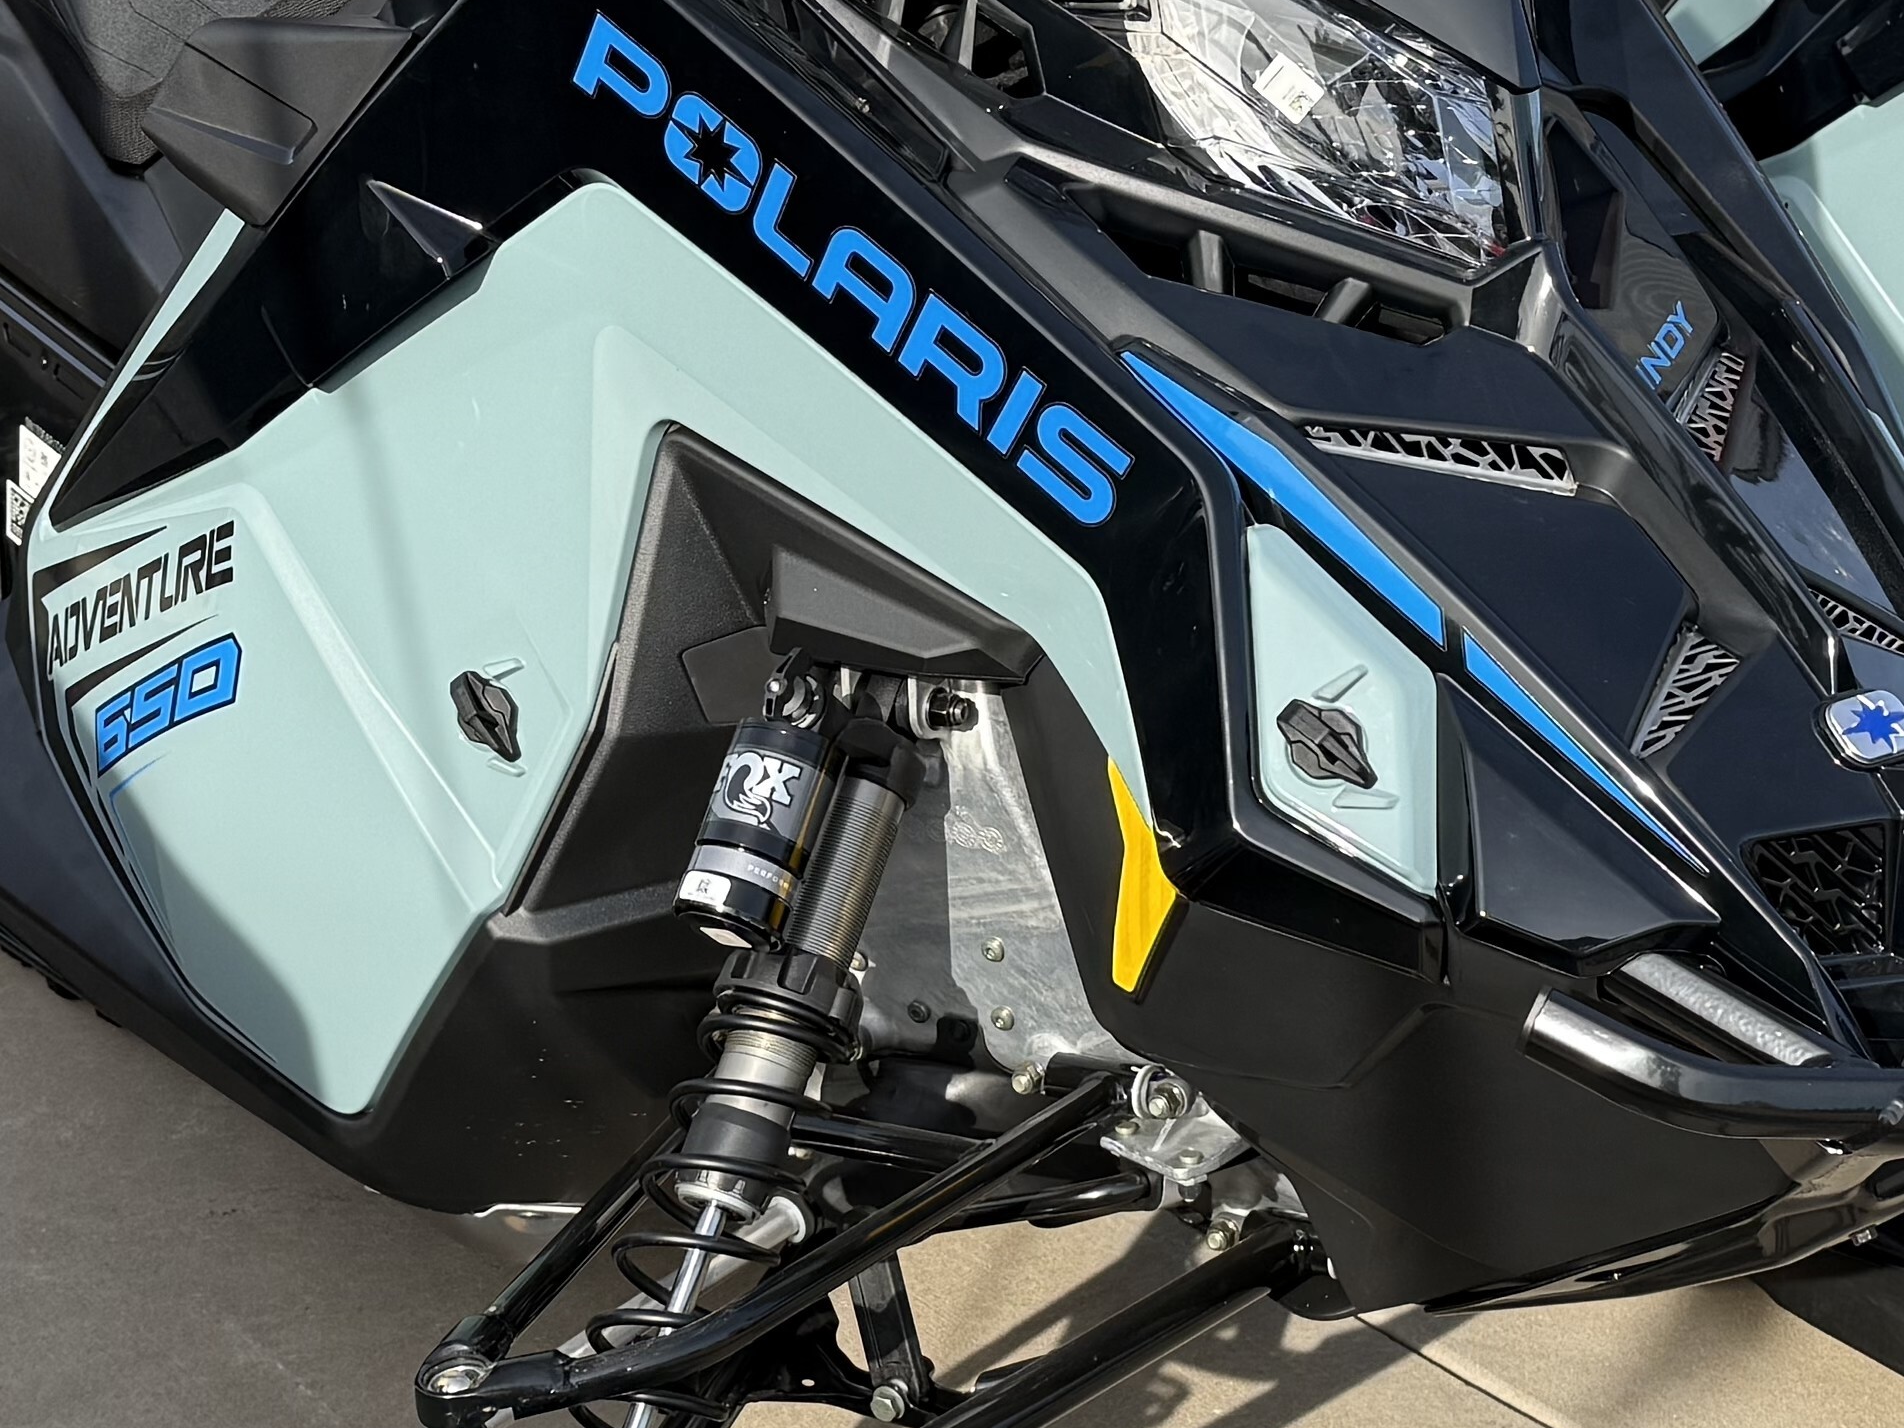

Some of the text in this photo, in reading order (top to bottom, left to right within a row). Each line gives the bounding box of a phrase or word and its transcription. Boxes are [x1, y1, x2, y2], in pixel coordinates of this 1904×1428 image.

[574, 13, 1132, 525] POLARIS
[1635, 300, 1694, 390] INDY
[46, 519, 236, 677] ADVENTURE
[95, 632, 242, 777] 650
